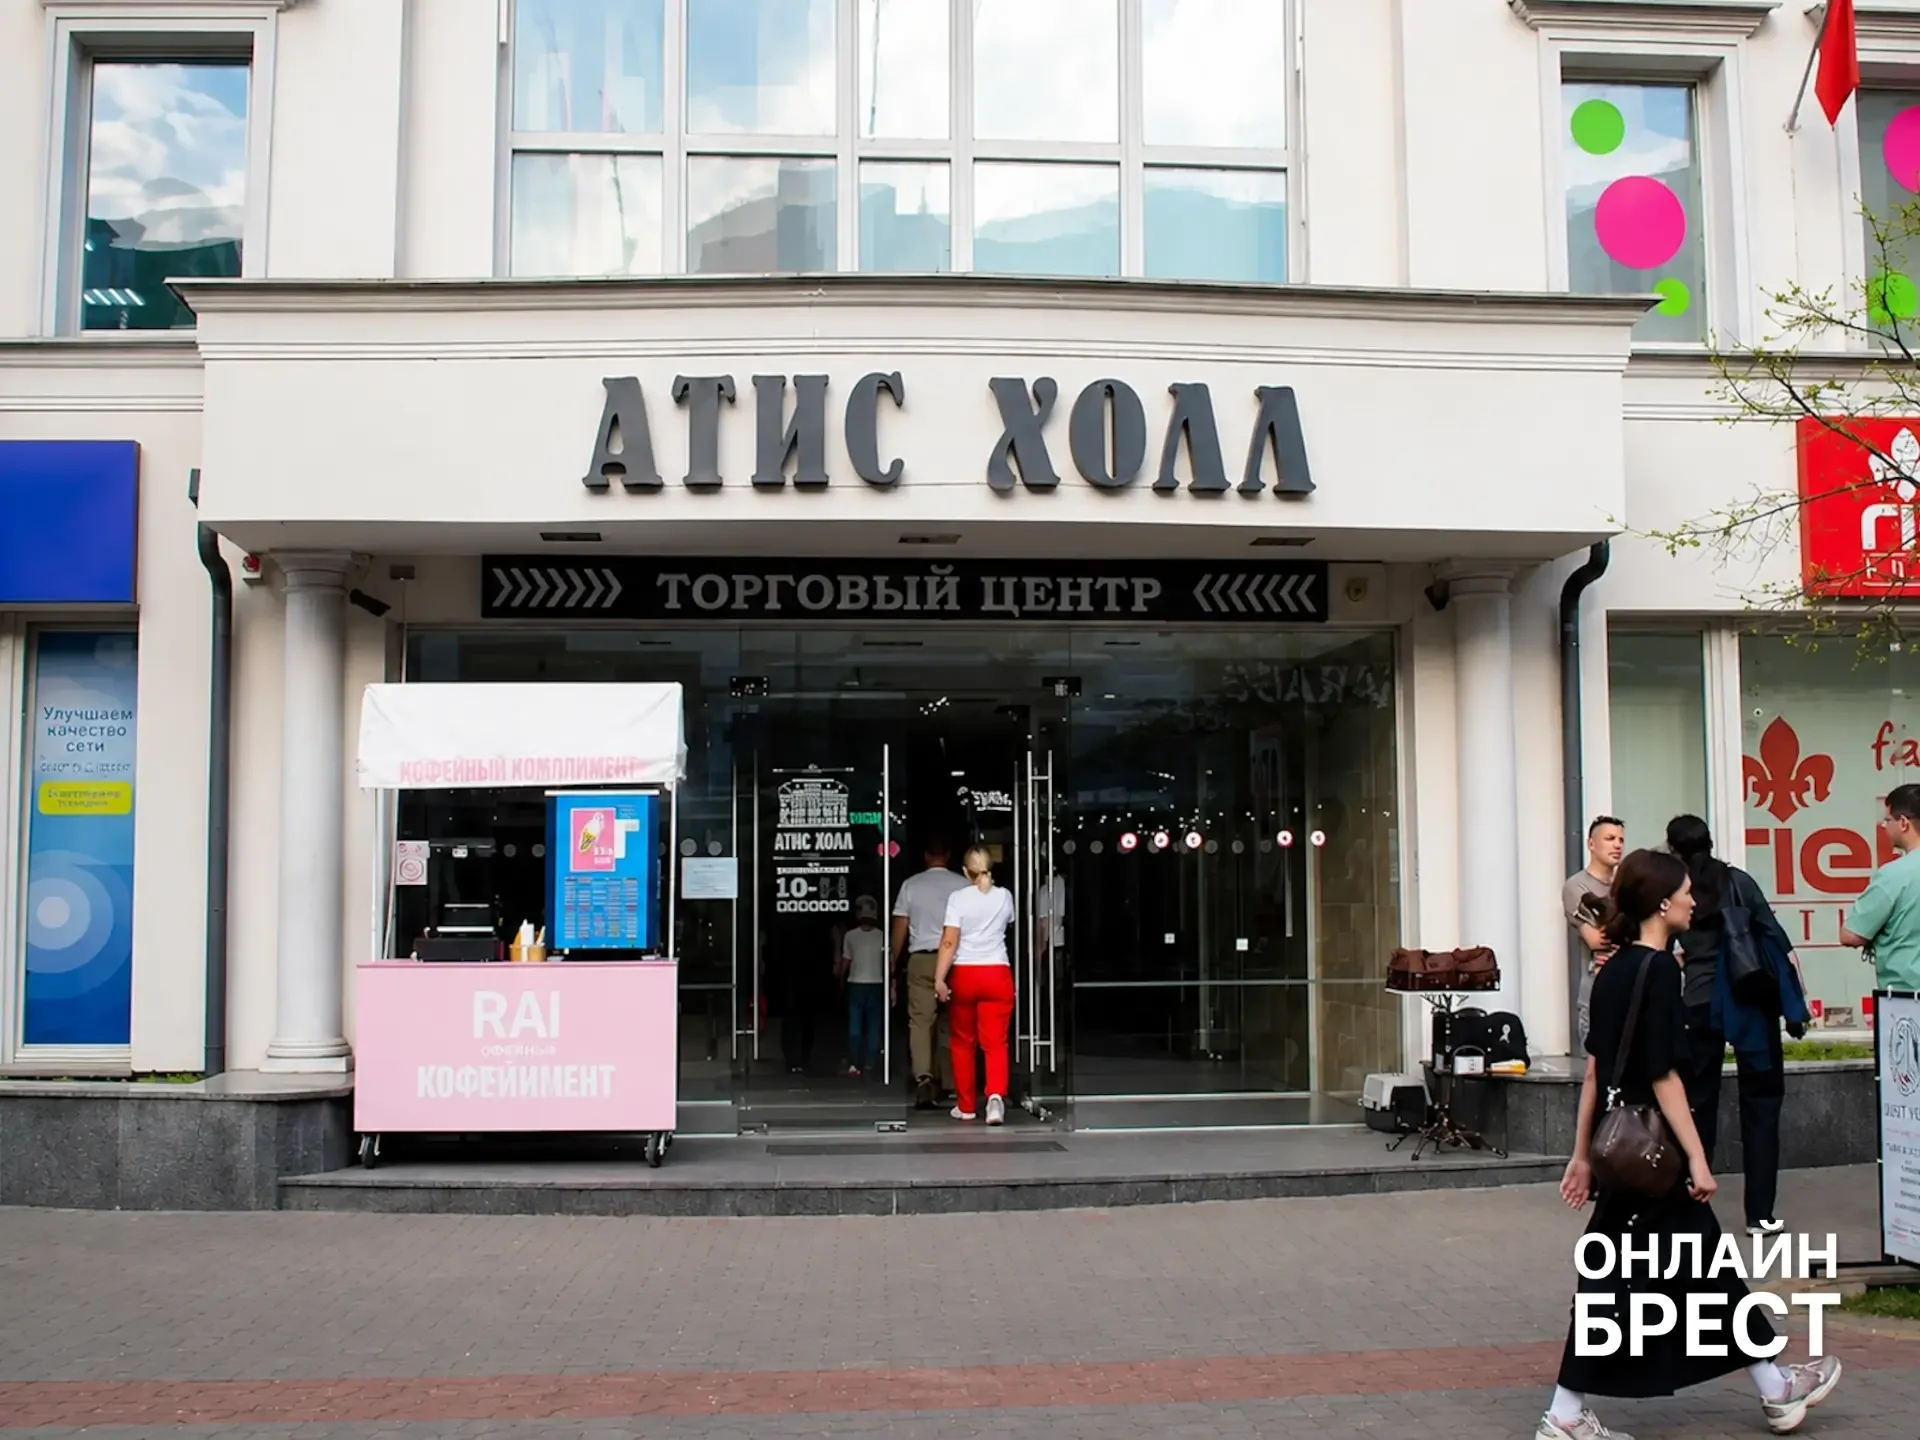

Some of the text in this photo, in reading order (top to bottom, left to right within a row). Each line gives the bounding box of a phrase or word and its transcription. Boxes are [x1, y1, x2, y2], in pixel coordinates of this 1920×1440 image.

[582, 371, 1317, 494] АТИС ХОЛЛ
[656, 564, 1162, 618] ТОРГОВЫЙ ЦЕНТР
[43, 706, 133, 724] Улучшаем
[47, 725, 127, 737] качество
[66, 741, 105, 753] сети
[472, 990, 561, 1039] RAI
